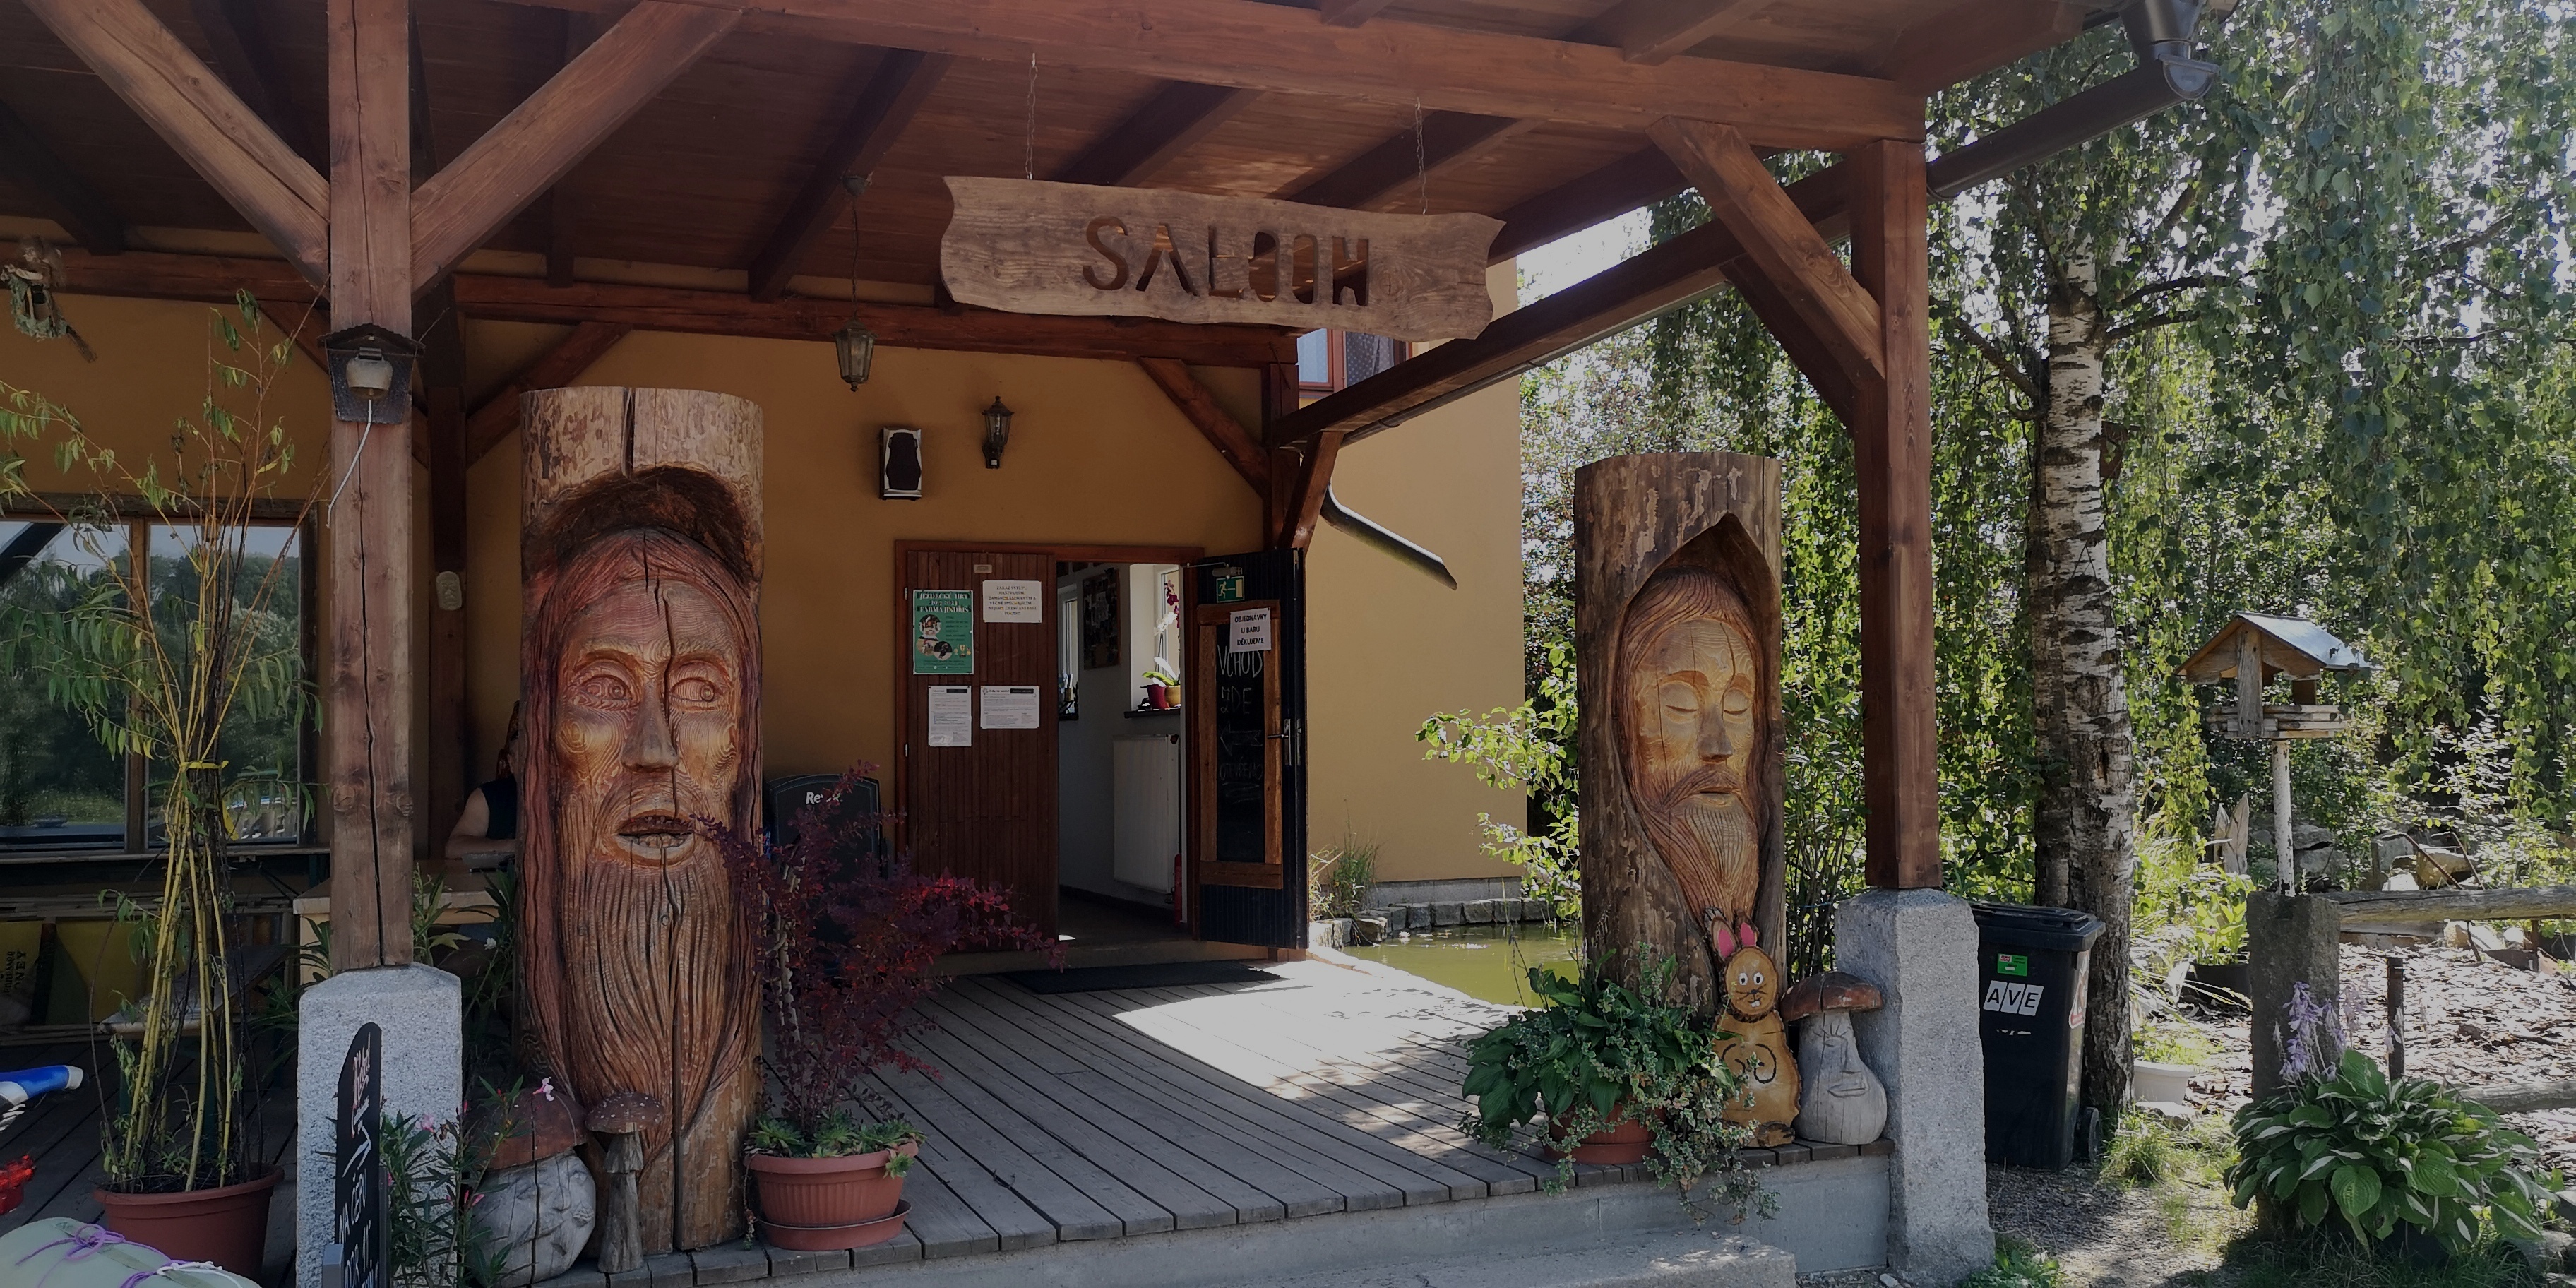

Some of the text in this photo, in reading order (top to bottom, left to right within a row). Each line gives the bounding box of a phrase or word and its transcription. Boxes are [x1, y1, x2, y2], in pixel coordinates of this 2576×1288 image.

[1083, 215, 1369, 306] SALOON
[1234, 614, 1267, 622] OBJEDNÁVKY
[1217, 644, 1263, 678] VCHOD
[1987, 988, 2039, 1008] AVE
[339, 1202, 350, 1244] NA
